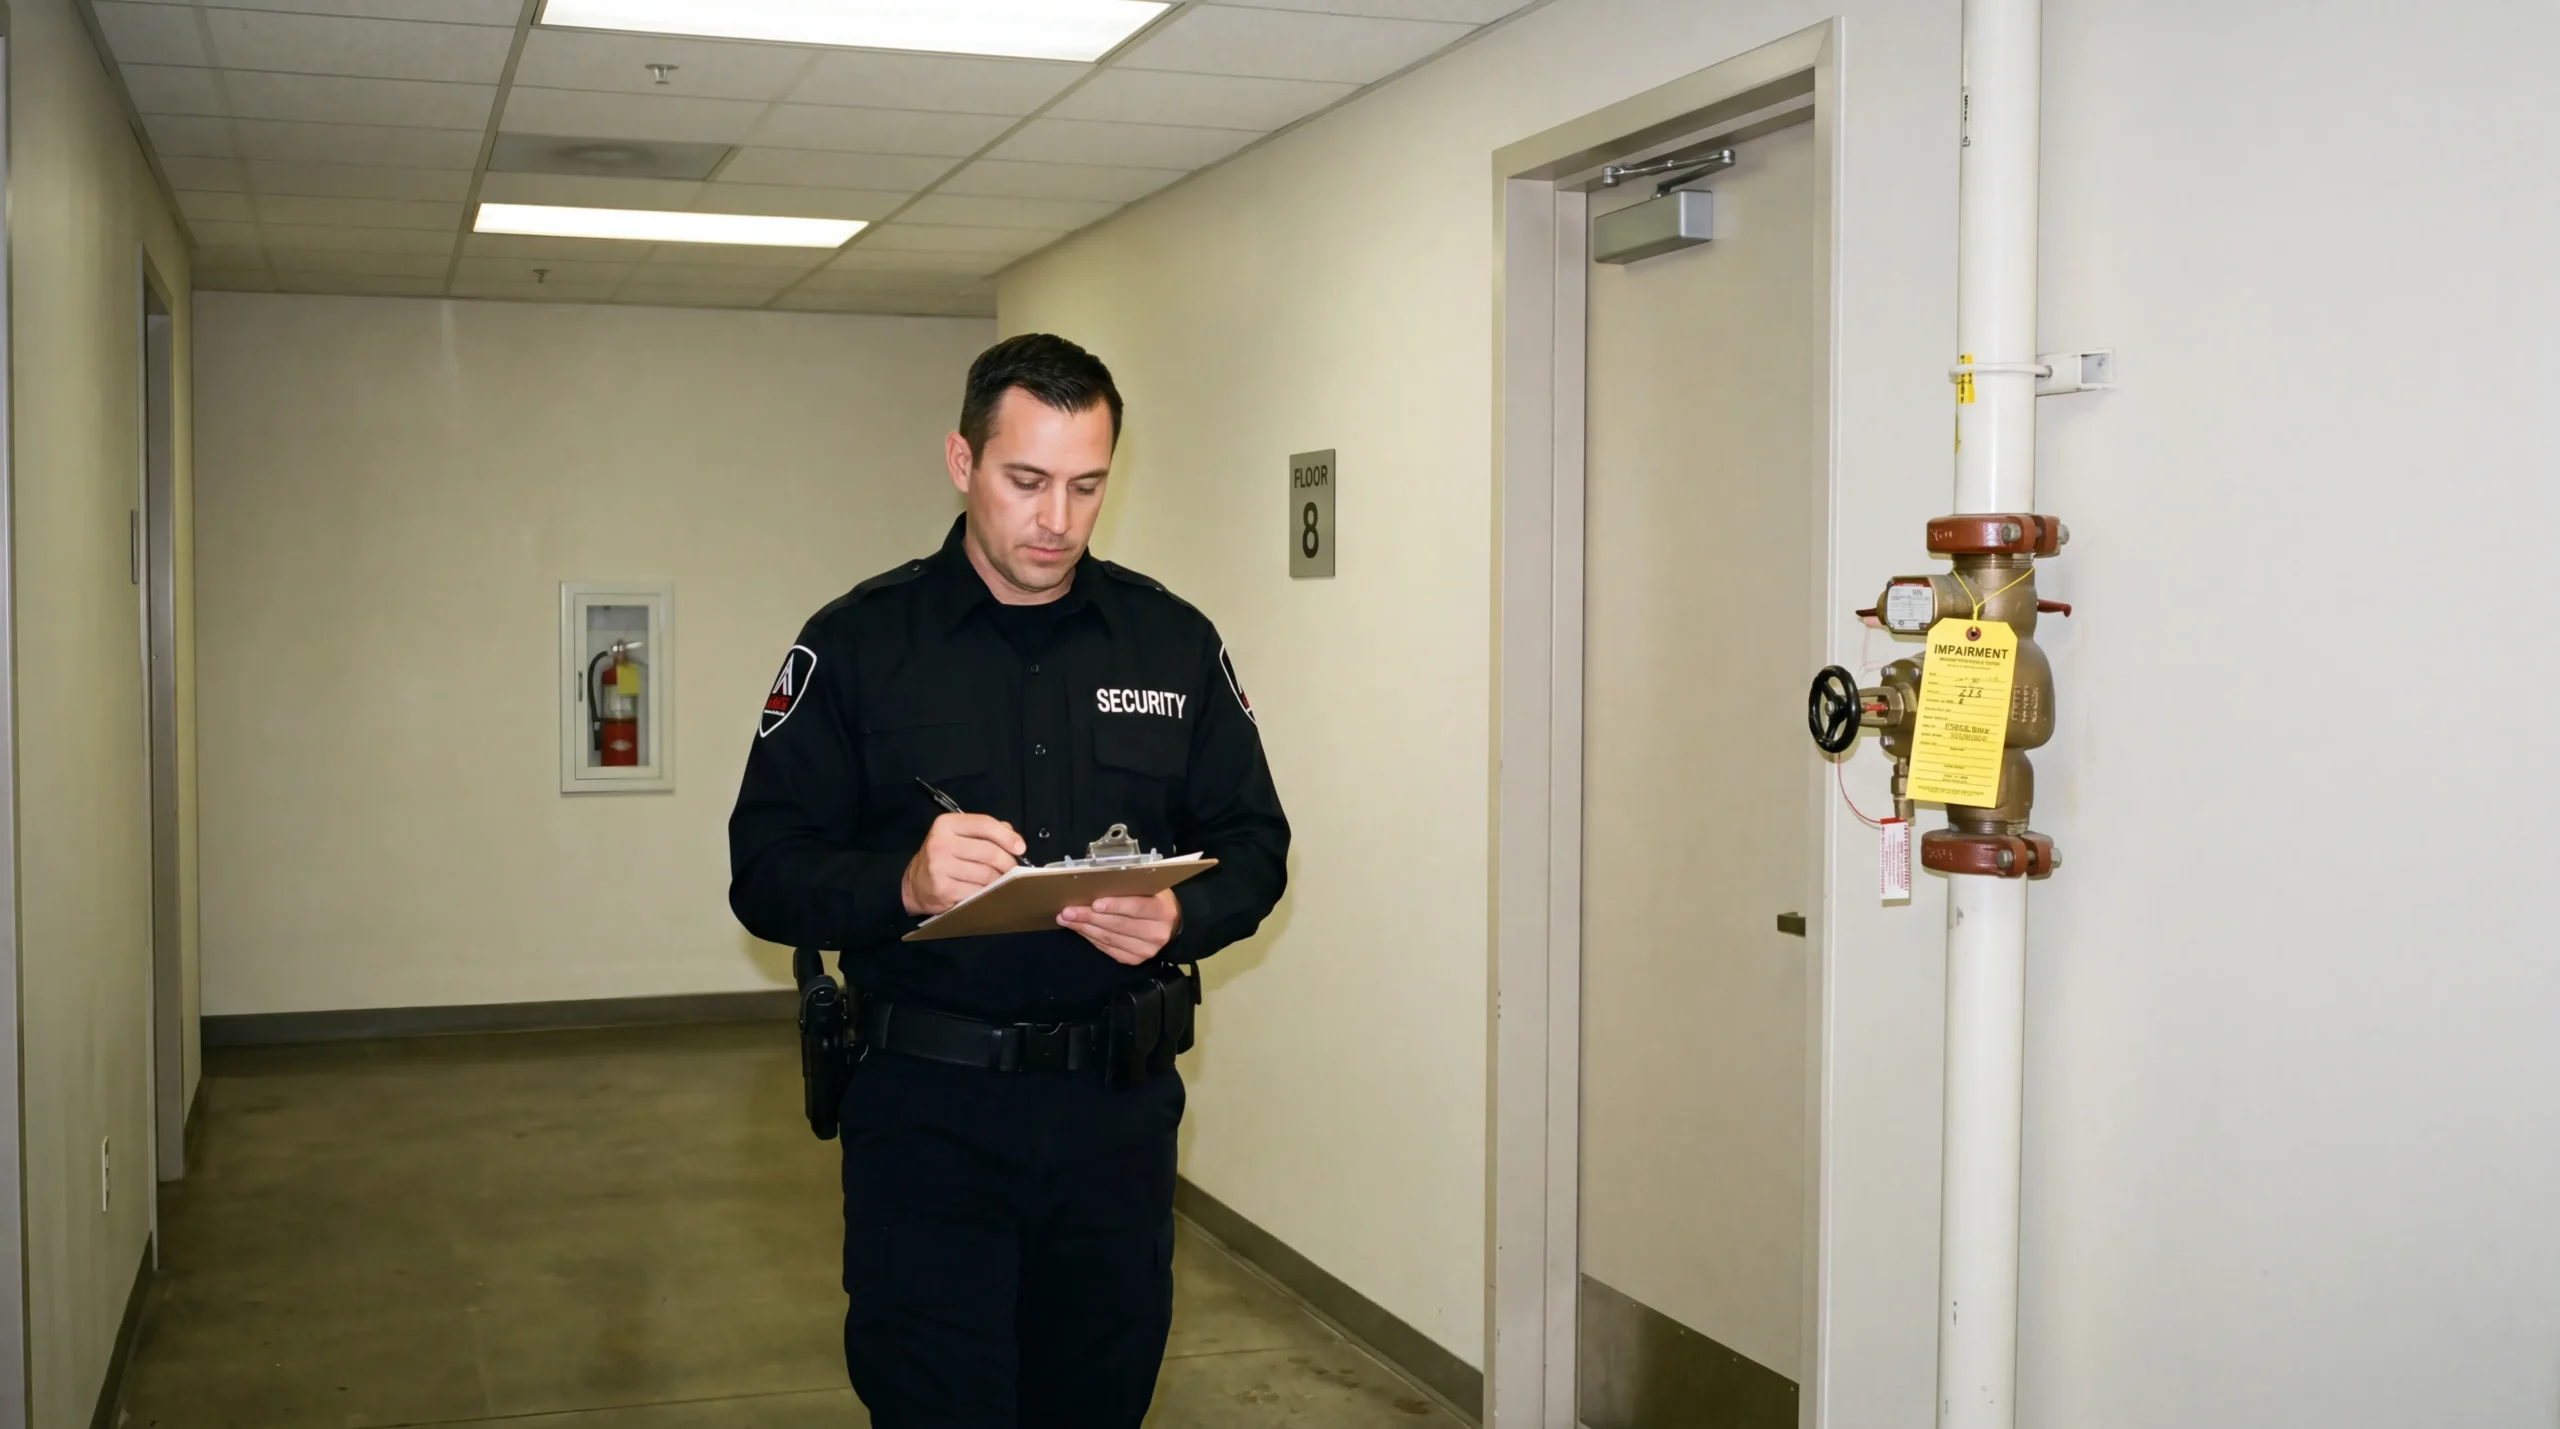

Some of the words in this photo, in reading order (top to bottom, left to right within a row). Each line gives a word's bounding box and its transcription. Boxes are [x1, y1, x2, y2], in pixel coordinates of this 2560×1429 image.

[1294, 465, 1328, 488] FLOOR
[1302, 501, 1319, 559] 8
[1934, 644, 2009, 660] IMPAIRMENT
[1096, 688, 1187, 719] SECURITY
